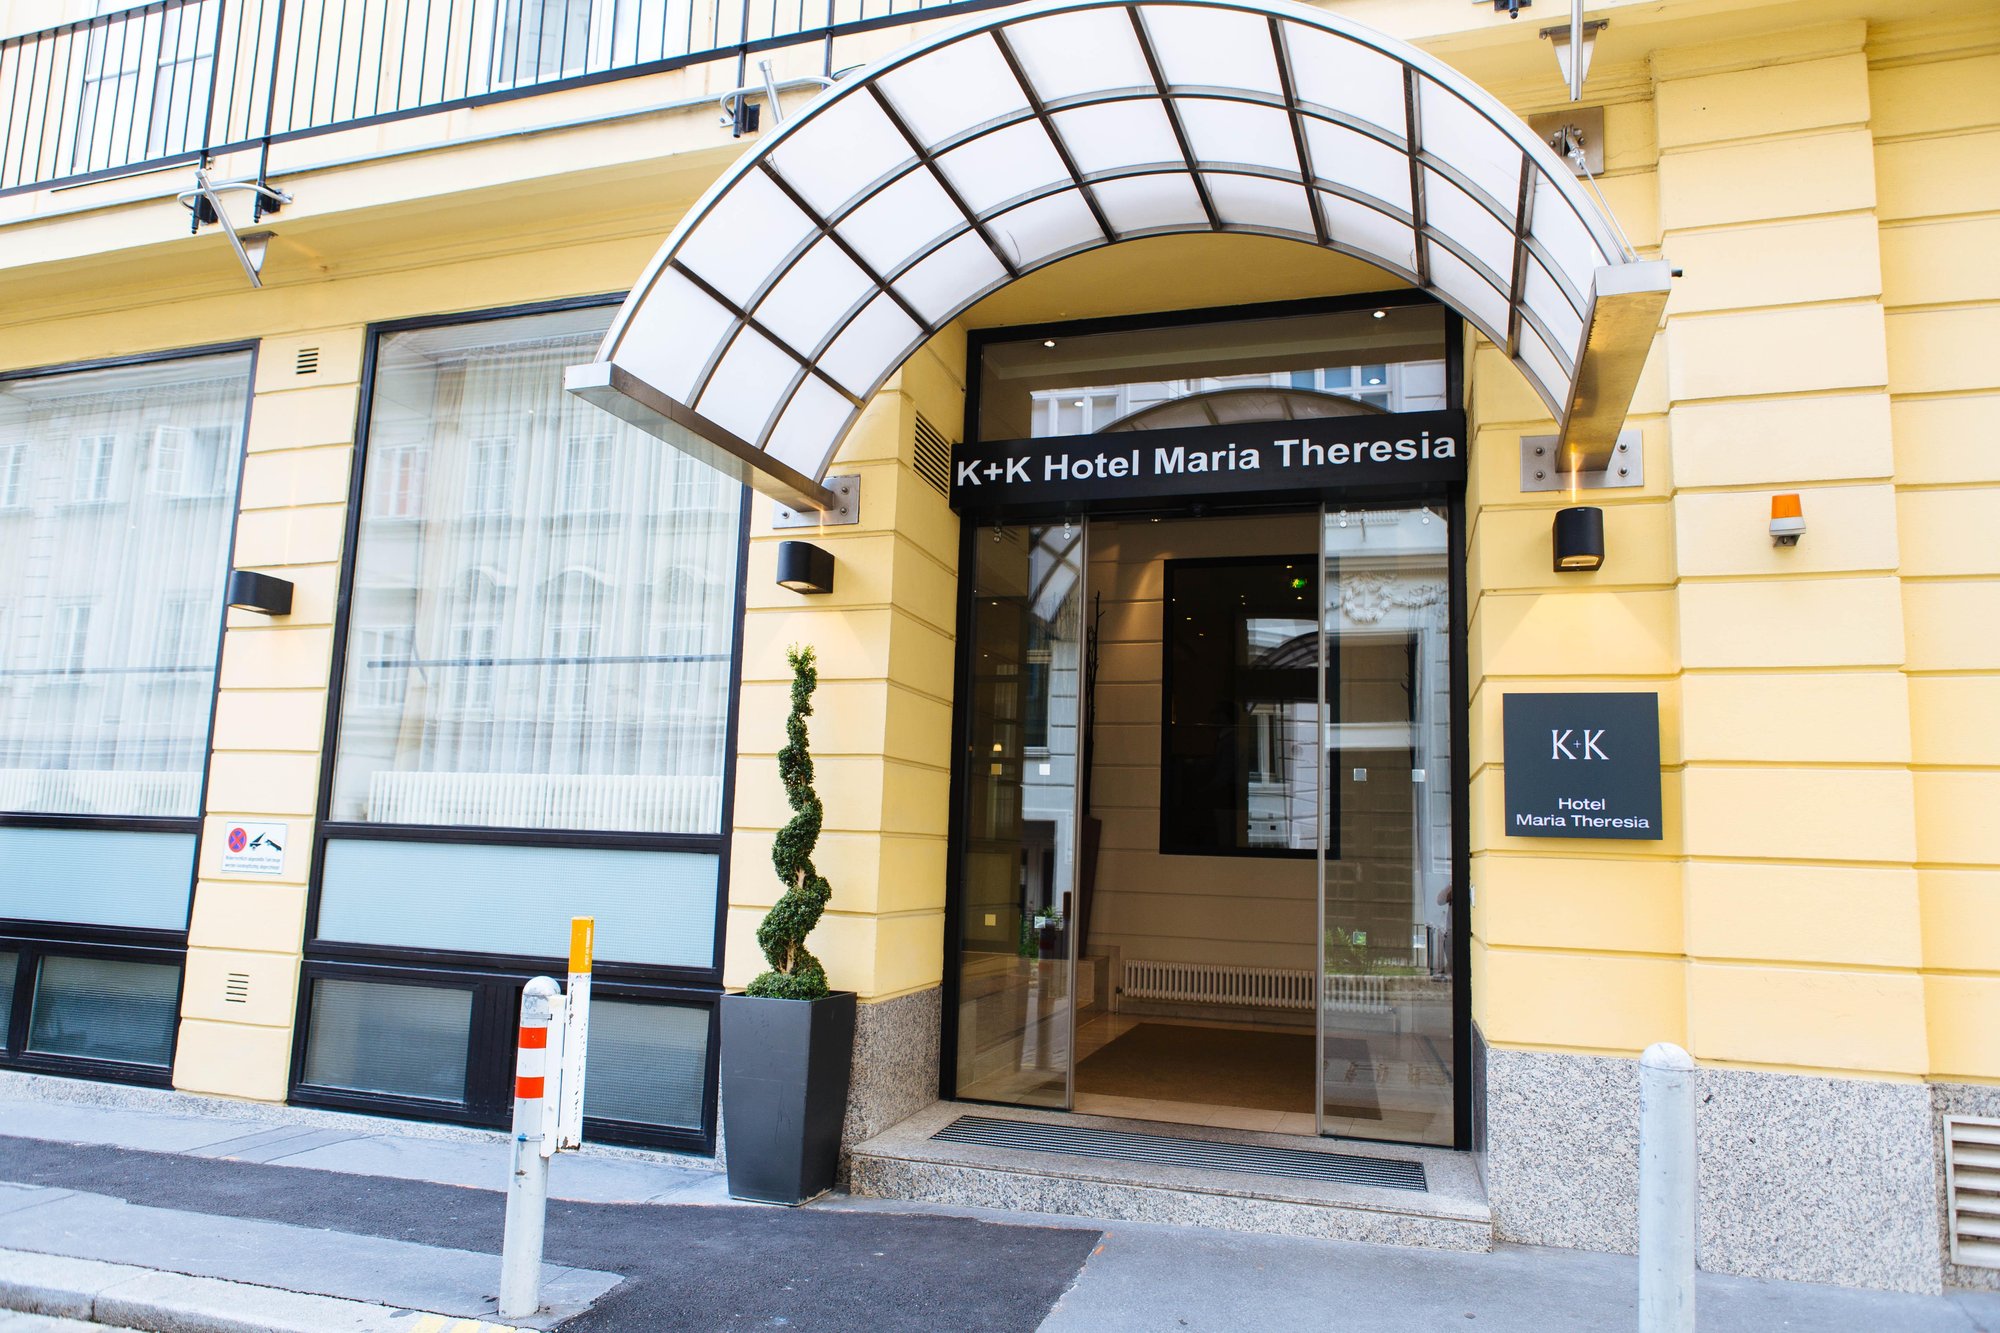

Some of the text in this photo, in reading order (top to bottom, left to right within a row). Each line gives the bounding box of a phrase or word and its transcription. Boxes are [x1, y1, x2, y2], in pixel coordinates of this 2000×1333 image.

[957, 431, 1457, 486] K+K Hotel Maria Theresia
[1551, 729, 1610, 760] K+K
[1558, 797, 1606, 811] Hotel
[1516, 813, 1650, 829] Maria Theresia
